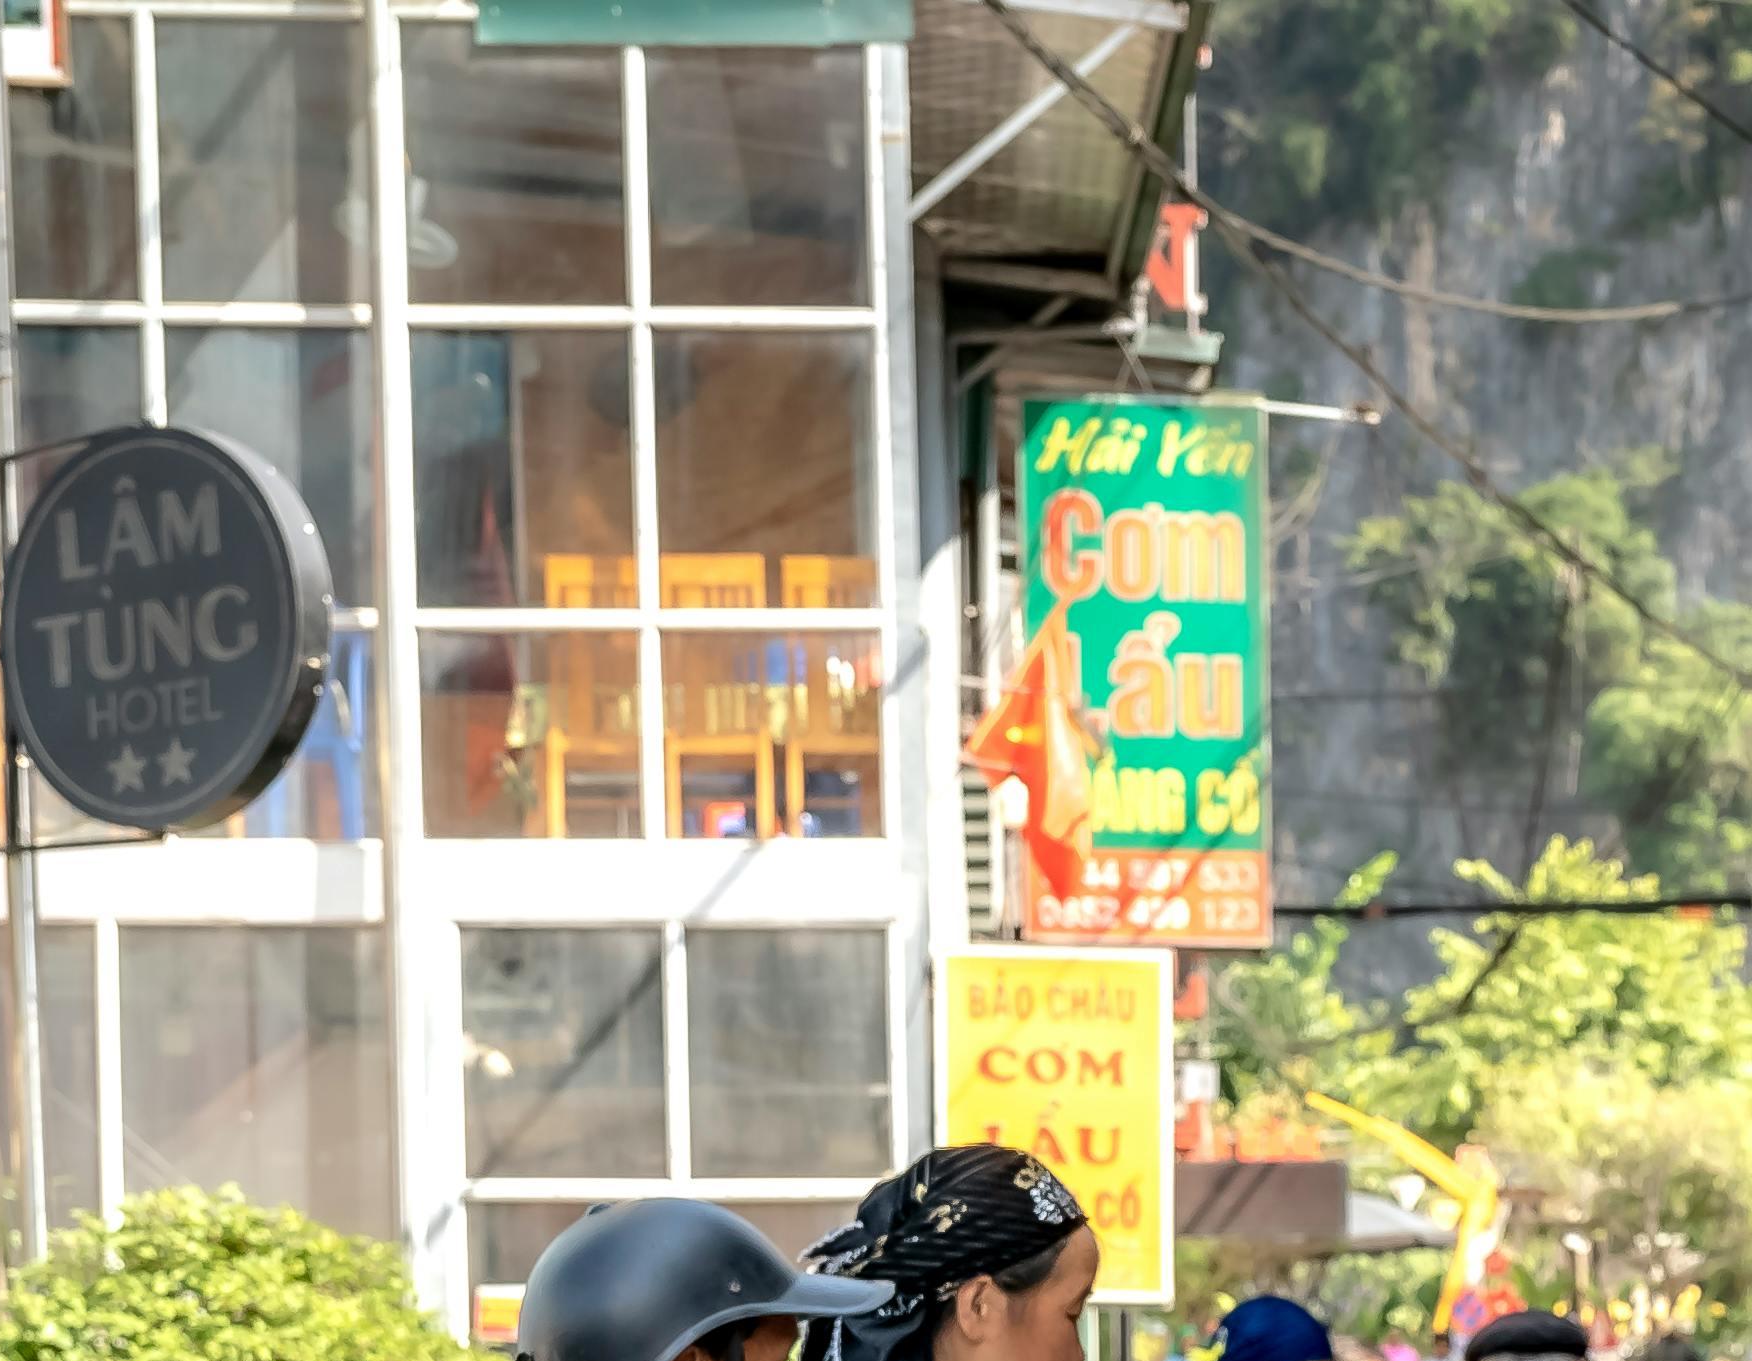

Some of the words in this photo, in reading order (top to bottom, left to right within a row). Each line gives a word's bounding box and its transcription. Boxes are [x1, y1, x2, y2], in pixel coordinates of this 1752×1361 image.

[55, 474, 223, 582] LÂM
[1040, 486, 1246, 604] Cơm
[86, 676, 225, 741] HOTEL
